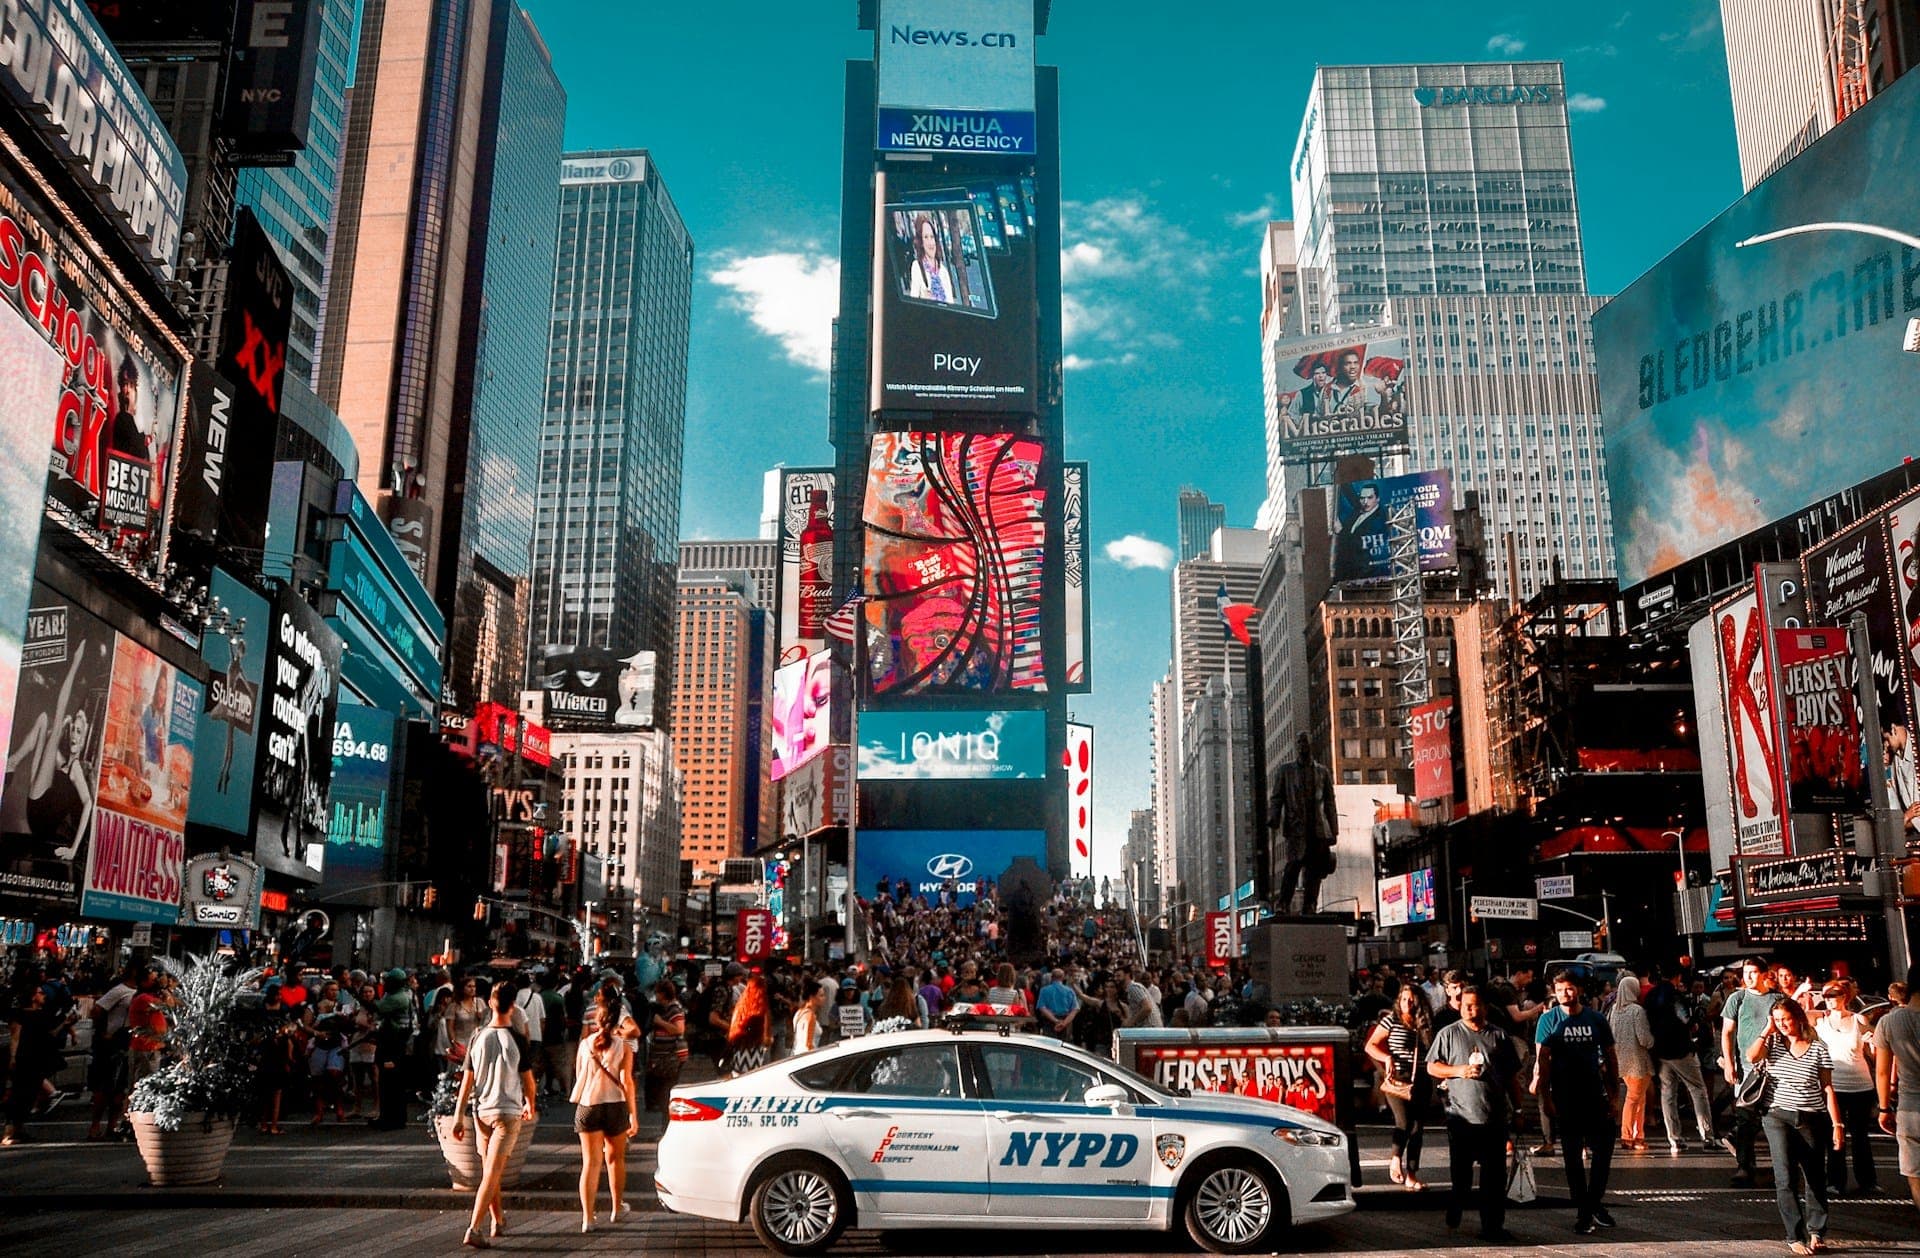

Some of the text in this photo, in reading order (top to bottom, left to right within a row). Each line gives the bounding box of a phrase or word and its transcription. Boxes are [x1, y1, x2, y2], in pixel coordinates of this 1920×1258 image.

[892, 25, 1015, 47] News.cn
[241, 89, 282, 102] NYC
[1441, 86, 1549, 105] BARCLAYS
[911, 115, 1002, 133] XINHUA
[891, 133, 1023, 149] NEWS AGENCY
[562, 164, 606, 179] lianz
[0, 215, 109, 408] SCHOOL
[60, 252, 111, 319] EMPOWERING
[111, 308, 144, 354] MESSAGE
[934, 354, 981, 376] Play
[1324, 399, 1355, 417] Les
[1282, 405, 1404, 439] Misérables
[54, 388, 108, 498] CK
[203, 387, 231, 496] NEW
[107, 459, 149, 494] BEST
[1412, 484, 1439, 494] YOUR
[105, 489, 148, 515] MUSICAL!
[1825, 535, 1867, 578] Winner!
[1824, 576, 1880, 619] Best Musical!
[28, 613, 65, 638] YEARS
[281, 612, 295, 648] Go
[276, 655, 300, 690] your
[1784, 656, 1849, 697] JERSEY
[176, 681, 199, 712] BEST
[550, 690, 607, 713] WICKED
[272, 693, 305, 734] routine
[1795, 691, 1843, 728] BOYS
[333, 721, 353, 739] IA
[332, 740, 388, 763] 694.68
[901, 730, 999, 761] IONIQ
[1762, 834, 1775, 844] BEST
[92, 807, 183, 906] WAITRESS
[0, 872, 76, 892] AGOTHEMUSICAL.COM
[199, 907, 238, 922] Sanrio
[1473, 898, 1502, 907] PEDESTRIAN
[1516, 900, 1529, 908] ZONE
[745, 913, 763, 955] tkts
[1564, 1025, 1592, 1037] ANU
[1154, 1056, 1327, 1100] JERSEY BOYS
[726, 1096, 826, 1113] TRAFFIC
[726, 1115, 748, 1128] 7759
[759, 1115, 777, 1128] SPL
[780, 1115, 799, 1128] OPS
[887, 1126, 934, 1139] COURTESY
[879, 1138, 960, 1152] PROFESSIONALISM
[1000, 1131, 1139, 1168] NYPD
[870, 1151, 914, 1163] RESPECT
